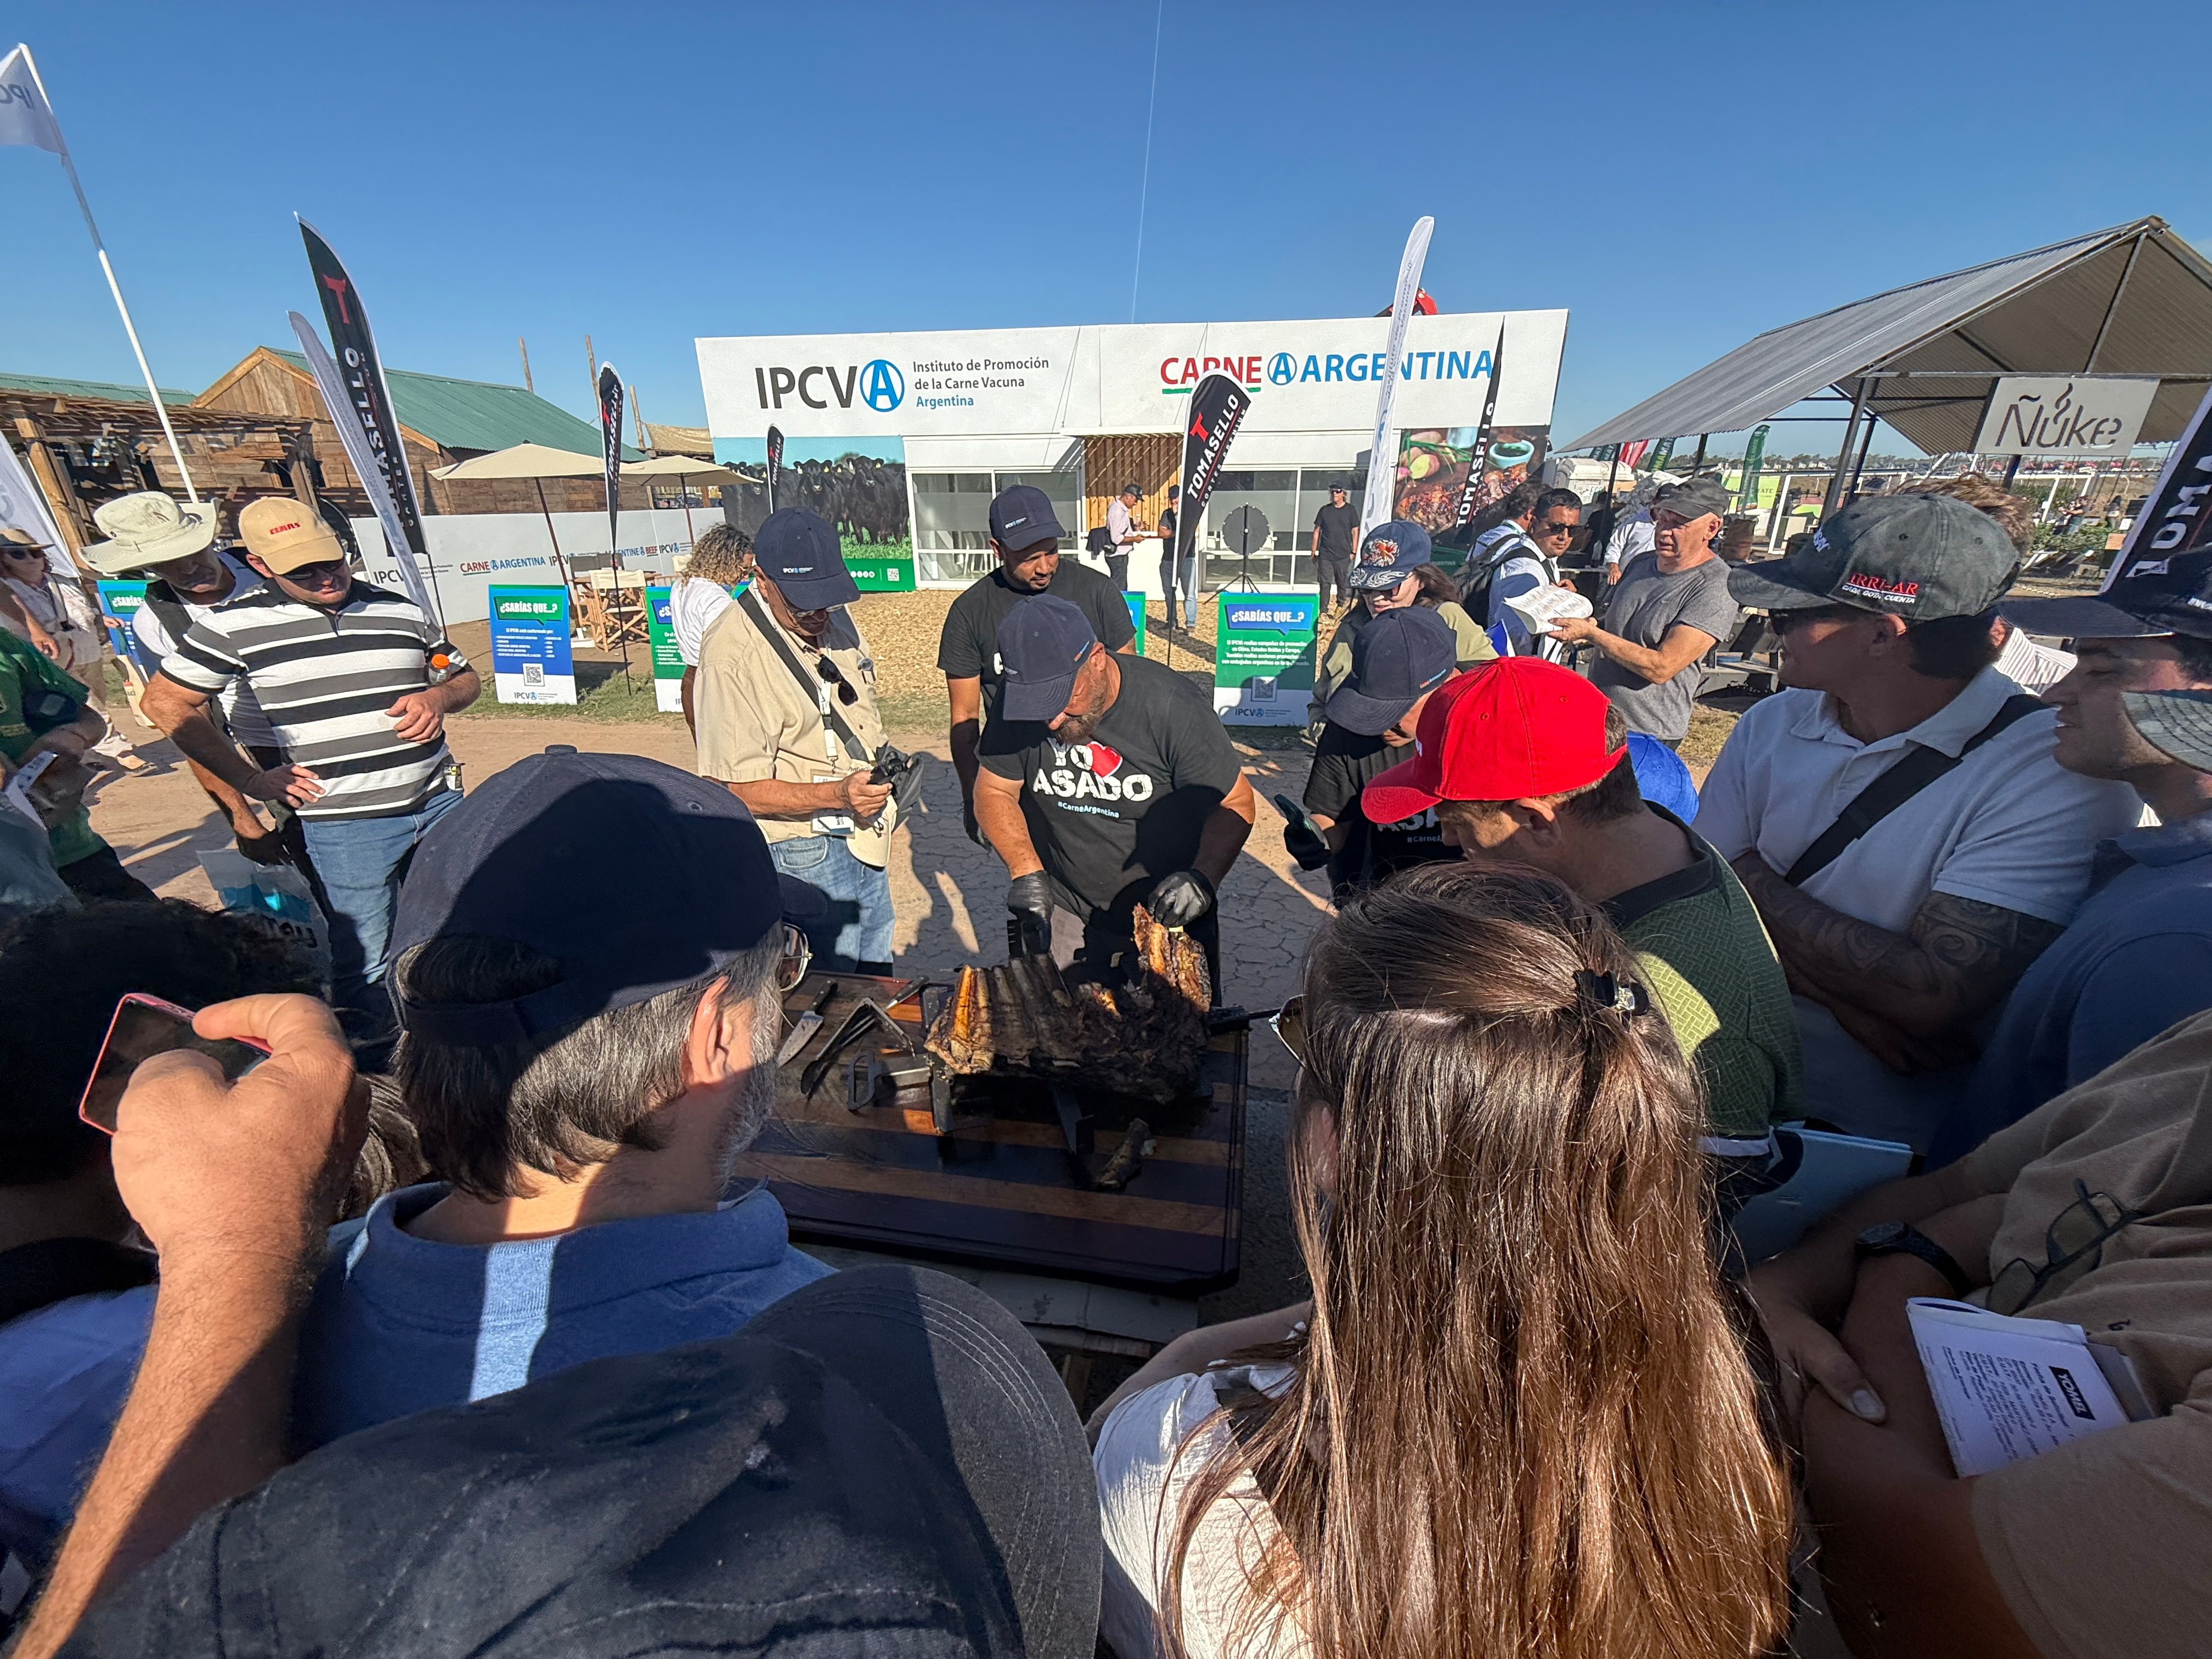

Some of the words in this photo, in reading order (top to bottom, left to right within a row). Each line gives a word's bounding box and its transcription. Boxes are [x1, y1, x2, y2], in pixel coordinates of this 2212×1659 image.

[913, 360, 964, 373] Instituto
[966, 359, 981, 371] de
[984, 356, 1049, 371] Promoción
[915, 378, 929, 390] de
[932, 377, 943, 389] la
[945, 377, 979, 389] Carne
[981, 376, 1025, 388] Vacuna
[916, 395, 974, 409] Argentina
[345, 347, 405, 528] OMASELLO
[1187, 393, 1239, 500] TOMASELLO
[1201, 464, 1222, 507] CORTES
[645, 545, 658, 555] BEEF
[460, 561, 490, 573] CARNE
[500, 556, 546, 569] ARGENTINA
[1849, 572, 1919, 595] IRRI-AR
[1842, 585, 1861, 595] CADA
[1863, 590, 1882, 599] GOTA
[1884, 594, 1916, 604] CUENTA
[500, 601, 532, 613] ¿SABÍAS
[1232, 609, 1272, 623] ¿SABÍAS
[514, 692, 538, 701] IPCVA
[1234, 707, 1265, 718] IPCVA
[1047, 737, 1093, 771] YO
[1032, 768, 1153, 802] ASADO
[1057, 801, 1120, 819] #CarneArgentina
[2057, 1372, 2088, 1415] YOMEL
